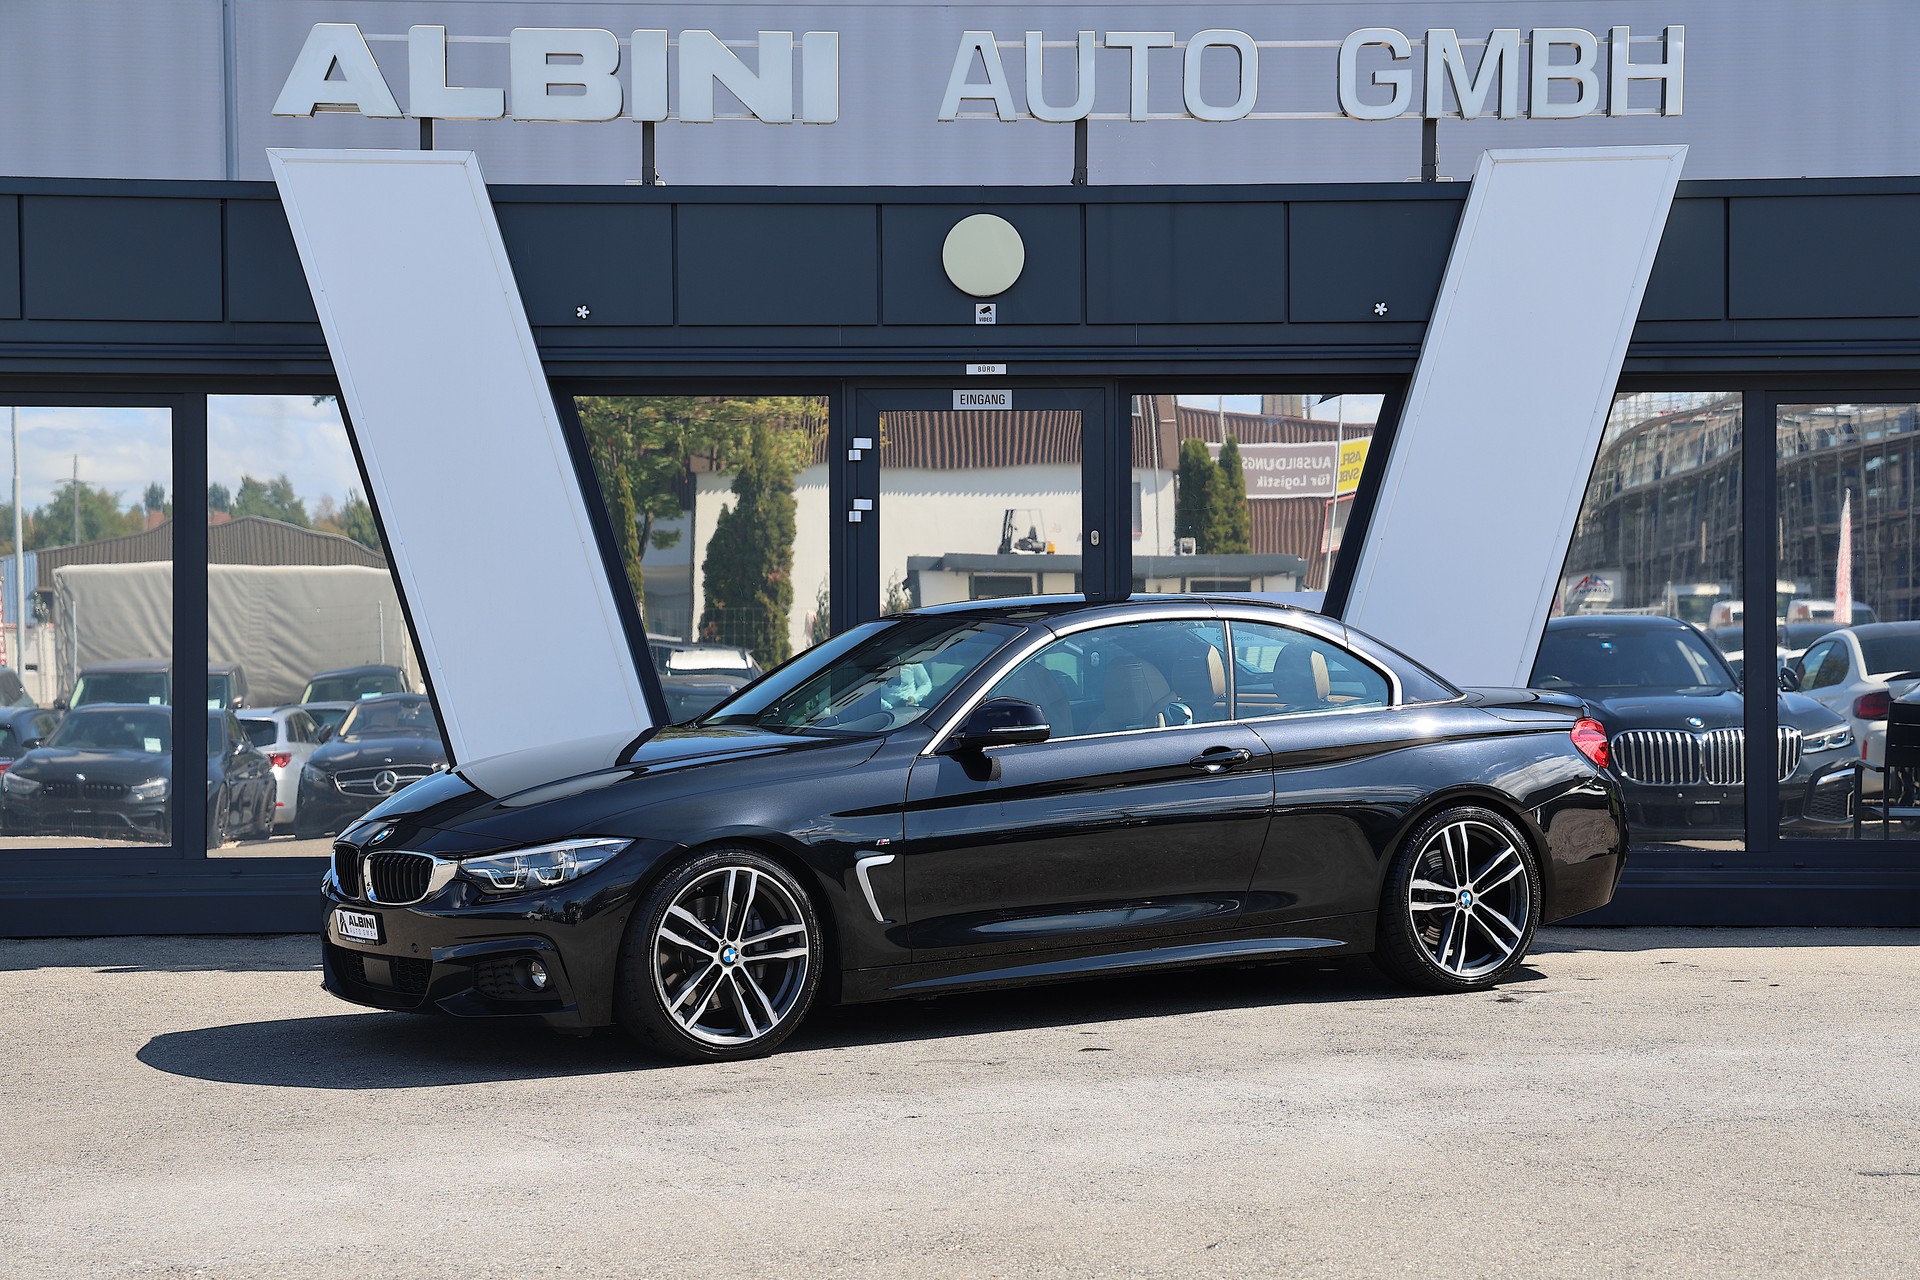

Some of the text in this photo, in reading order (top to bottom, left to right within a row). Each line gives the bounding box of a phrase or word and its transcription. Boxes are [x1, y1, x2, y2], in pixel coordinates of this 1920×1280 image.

[271, 22, 1685, 125] ALBINI AUTO GMBH
[960, 394, 1006, 405] EINGANG
[349, 915, 375, 929] ALBINI
